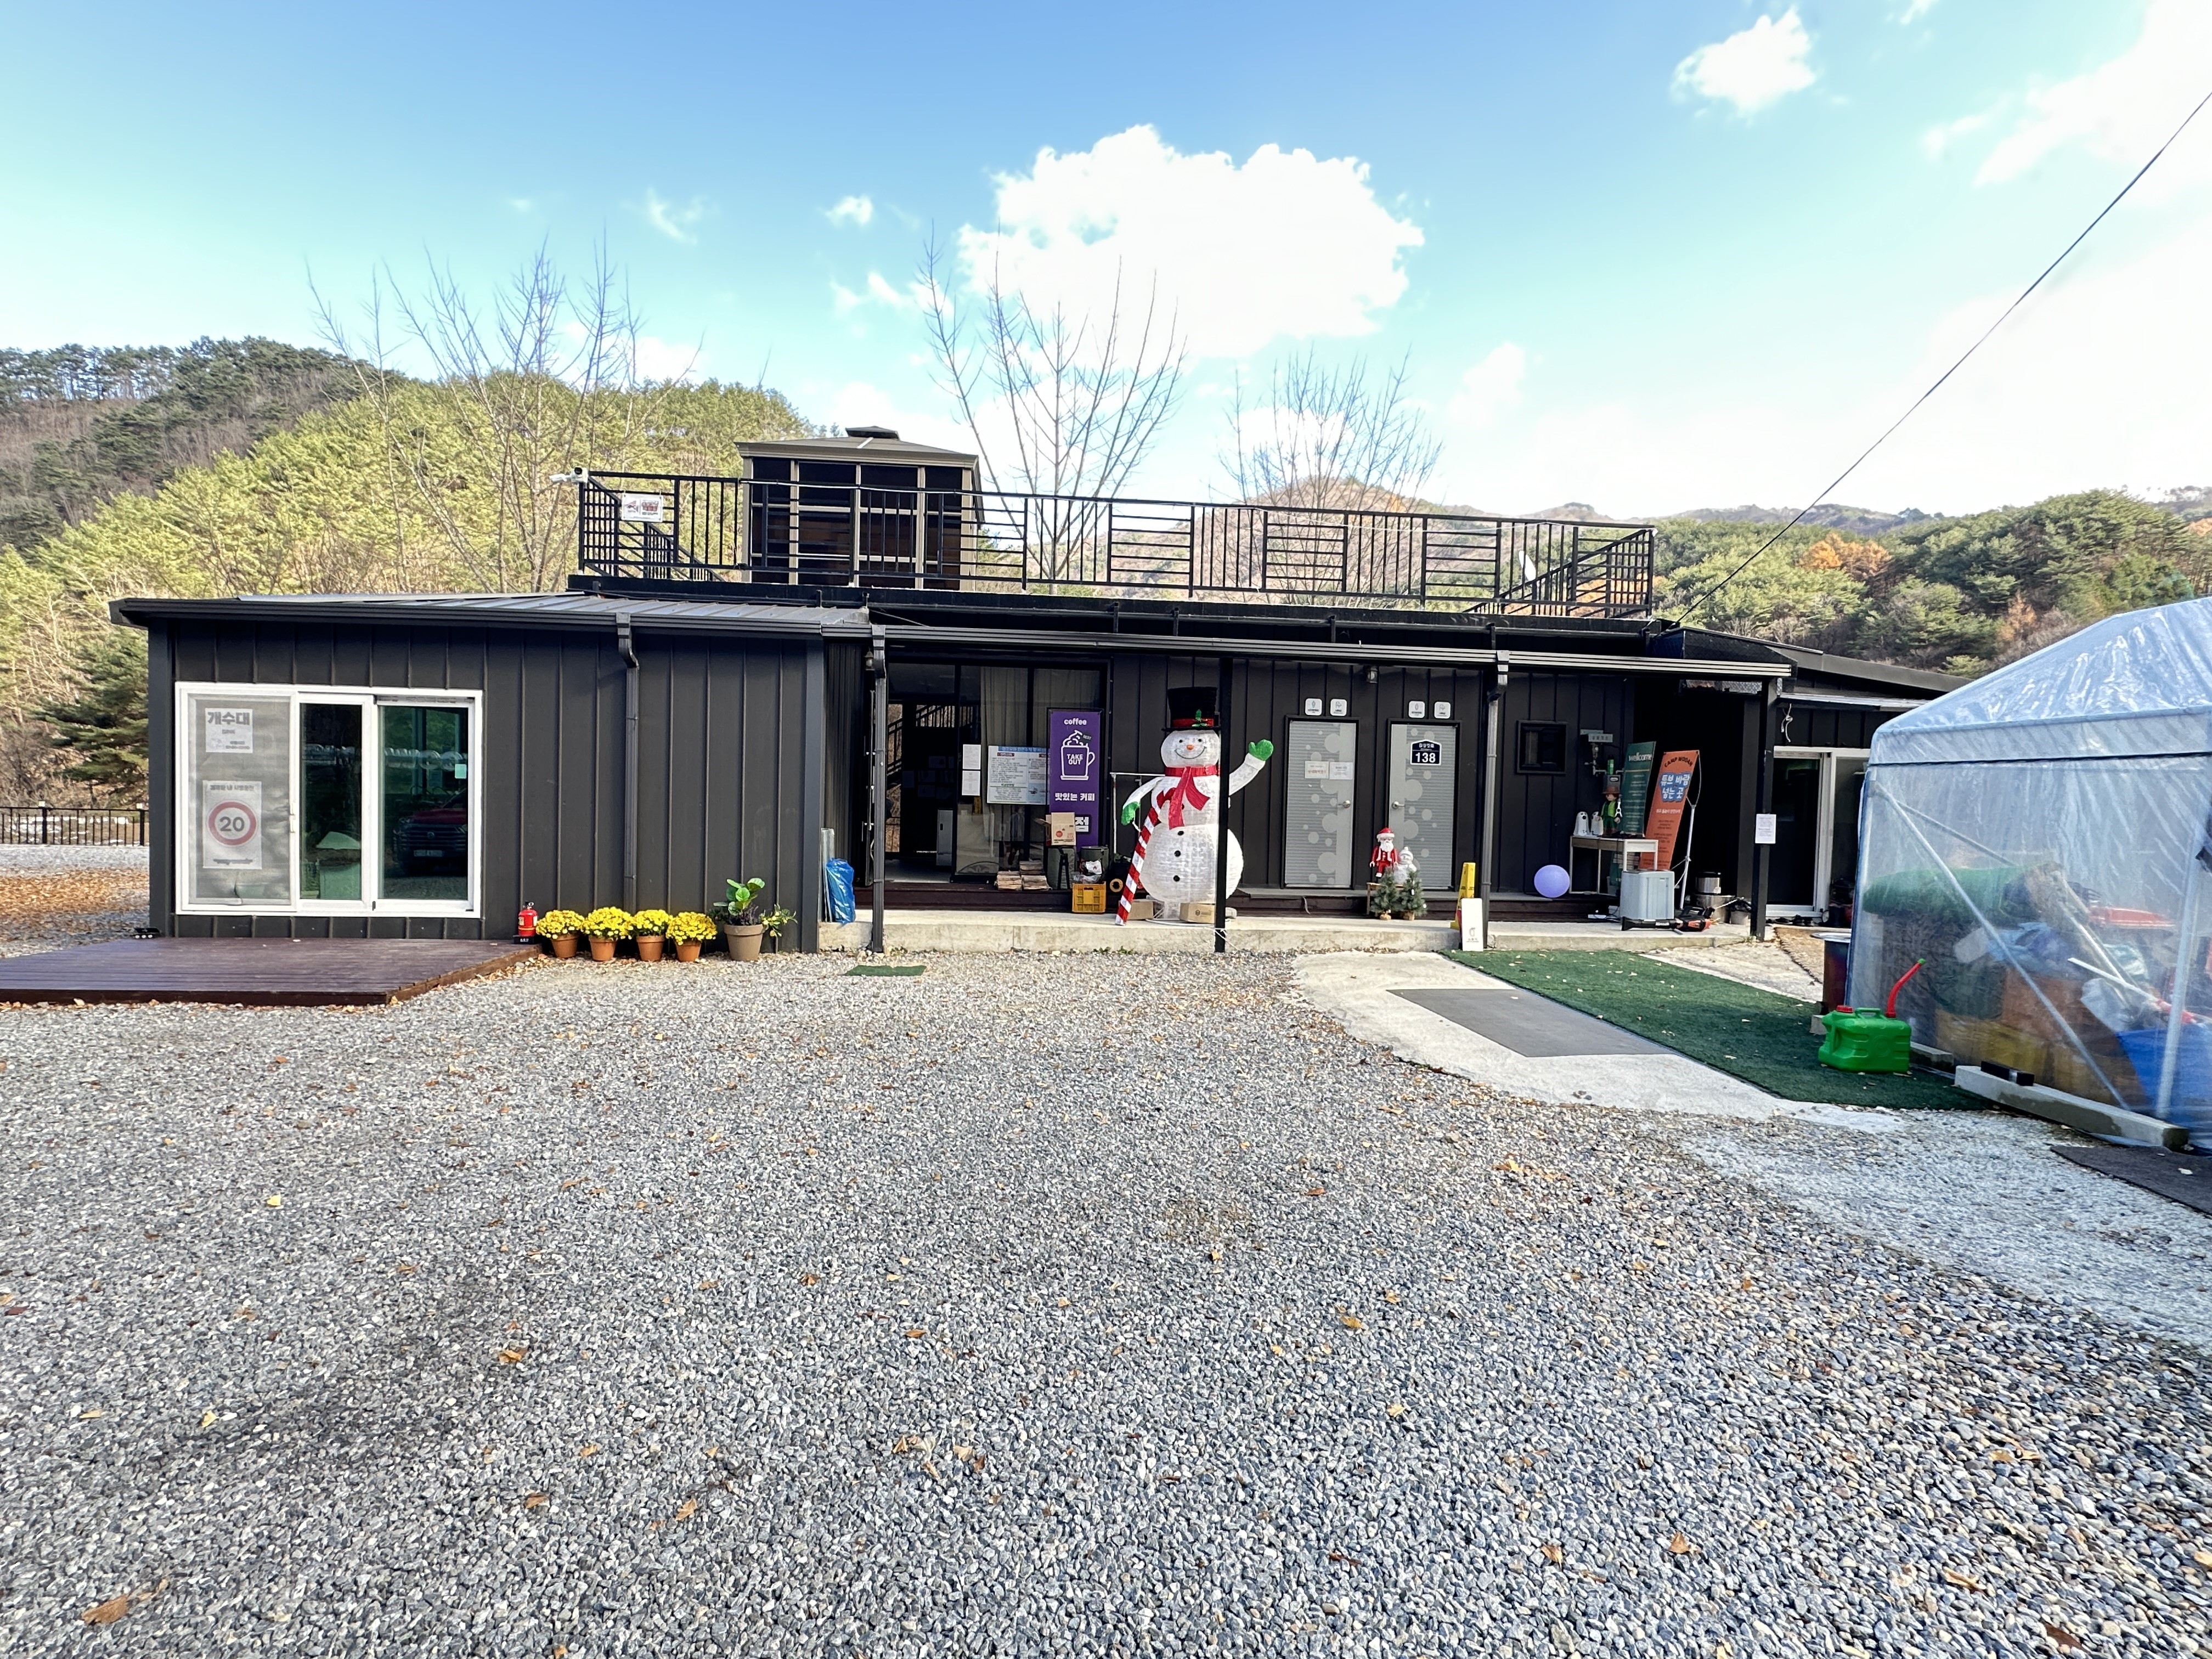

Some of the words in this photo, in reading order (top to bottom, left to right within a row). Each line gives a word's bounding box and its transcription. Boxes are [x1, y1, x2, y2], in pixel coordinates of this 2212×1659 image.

[208, 712, 250, 725] 개수대
[1415, 752, 1436, 763] 138
[1628, 752, 1652, 761] welcome
[1664, 757, 1678, 768] CAMP
[1660, 774, 1674, 787] 튜브
[1675, 774, 1690, 786] 바람
[1055, 792, 1077, 801] 맛있는
[1080, 793, 1095, 802] 커피
[1662, 787, 1675, 799] 넣는
[1676, 787, 1684, 799] 곳
[219, 816, 245, 832] 20
[1075, 816, 1090, 832] 점
